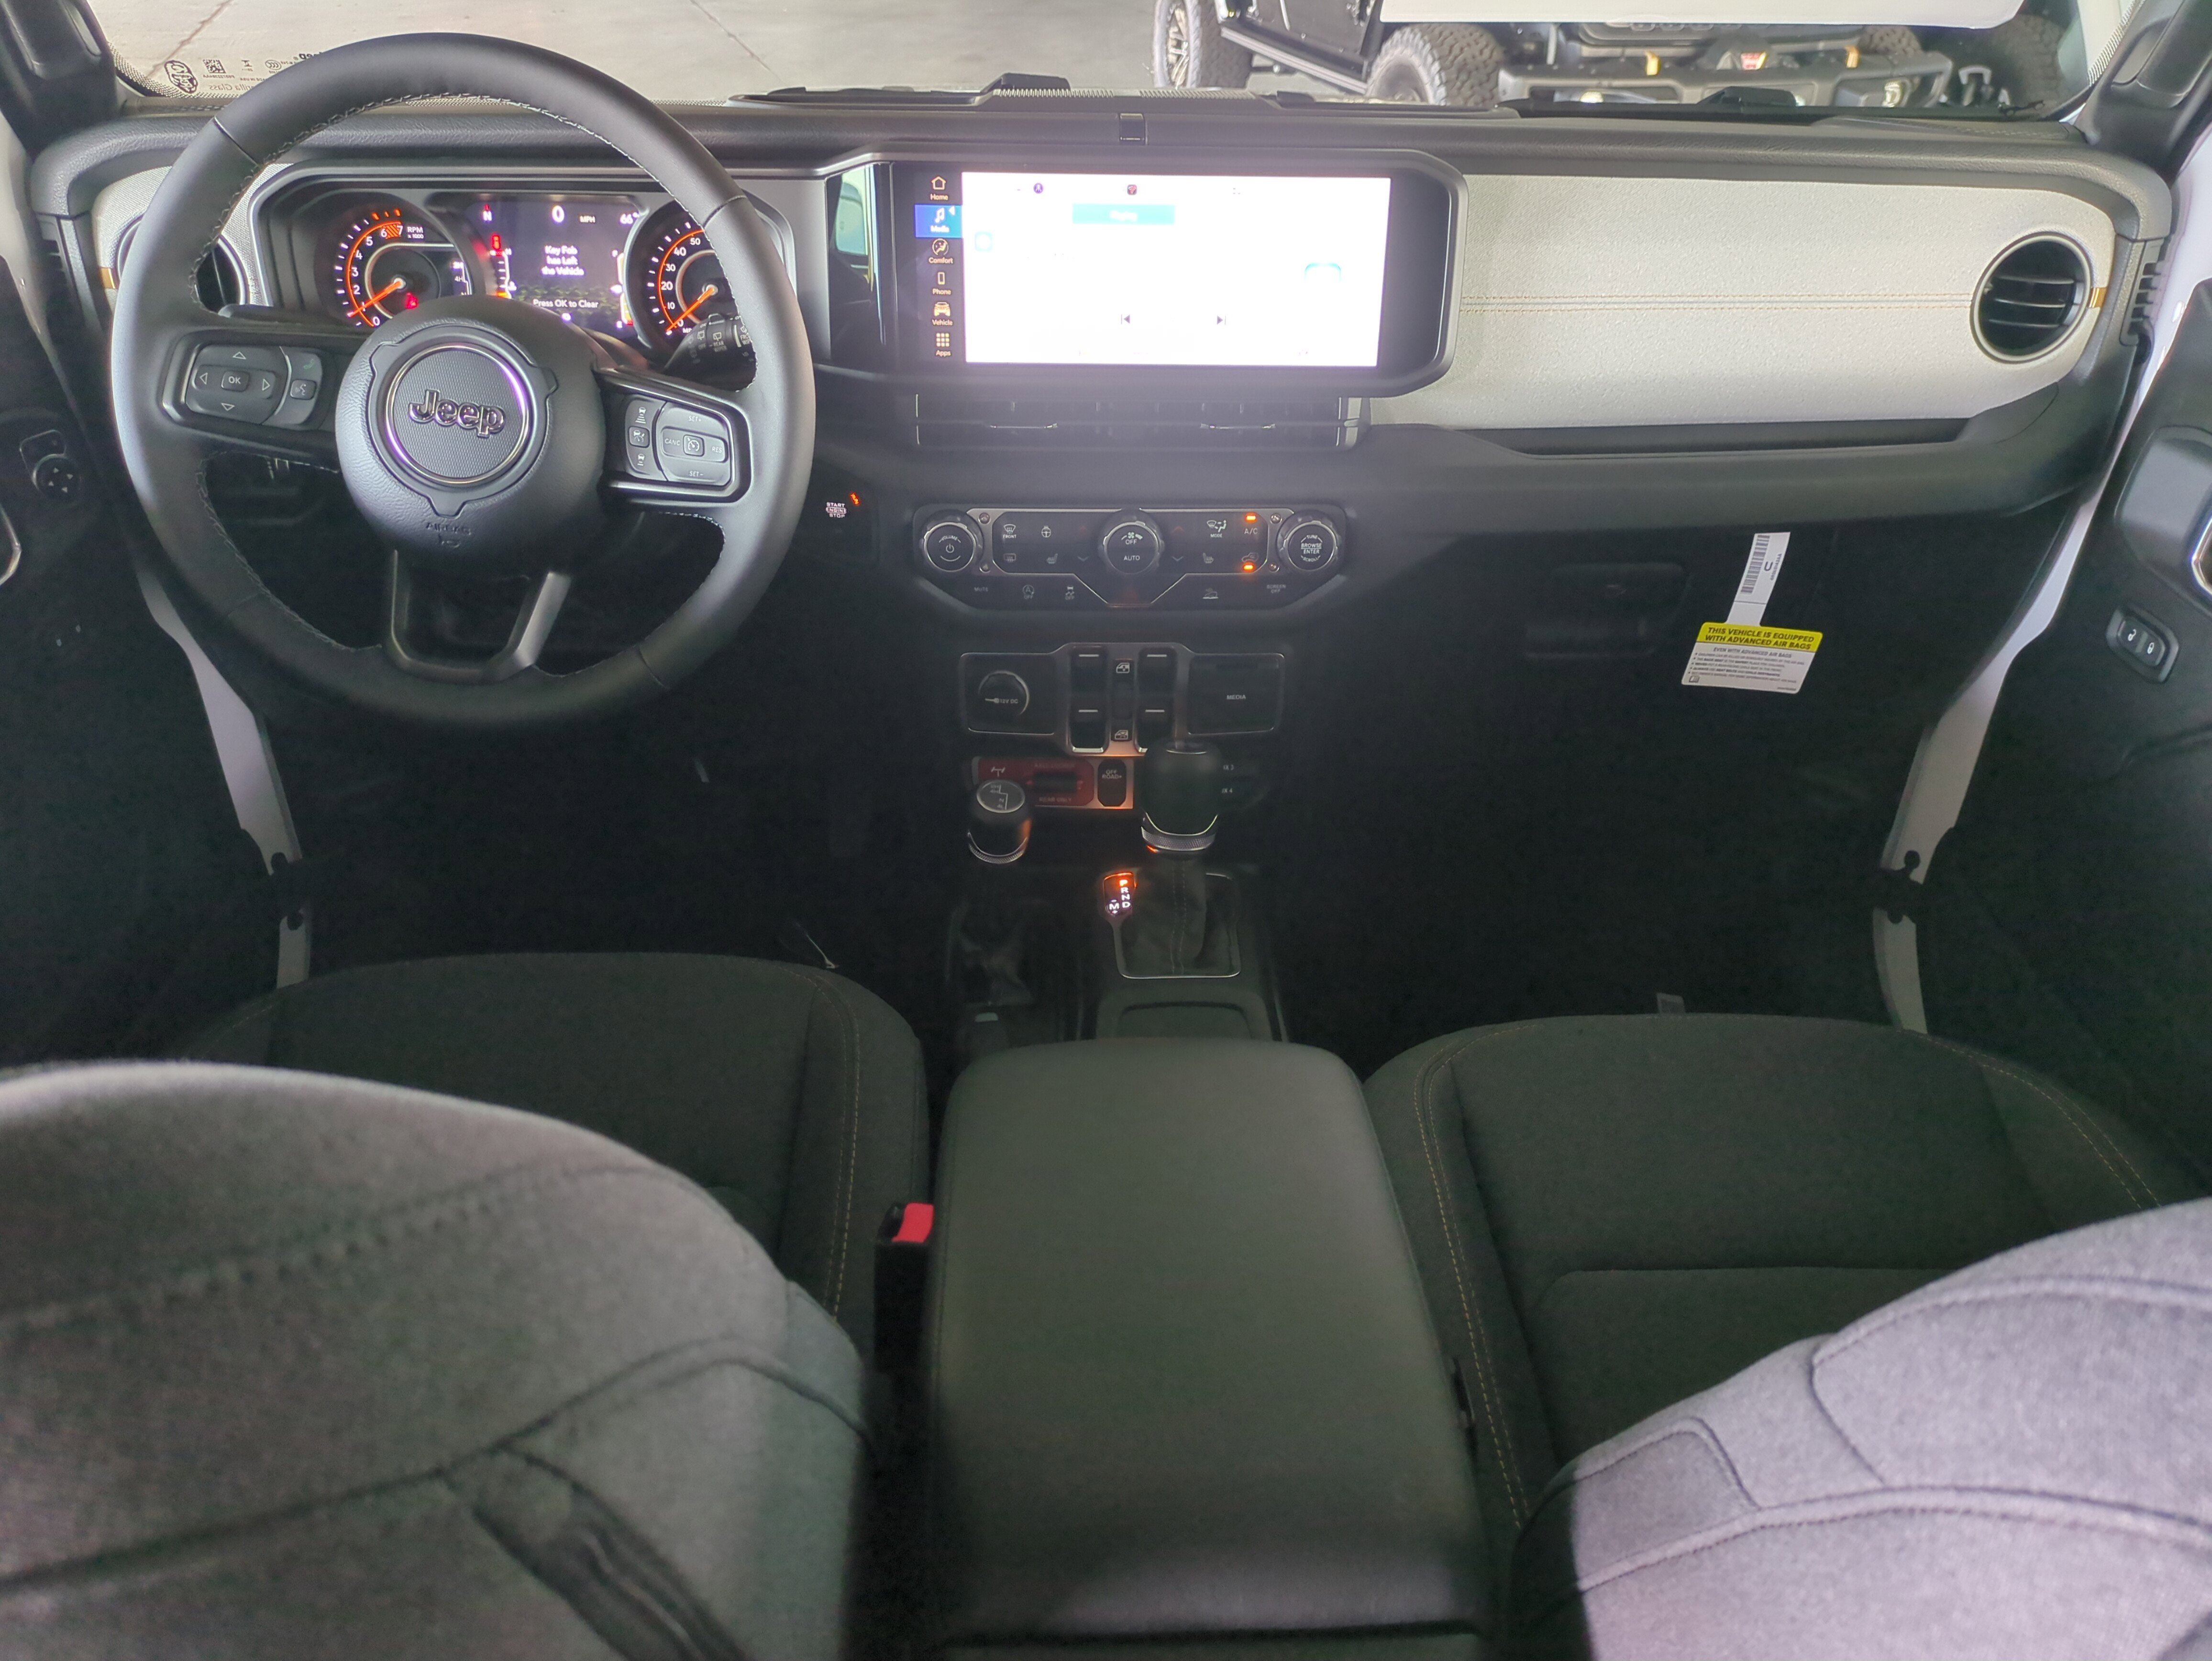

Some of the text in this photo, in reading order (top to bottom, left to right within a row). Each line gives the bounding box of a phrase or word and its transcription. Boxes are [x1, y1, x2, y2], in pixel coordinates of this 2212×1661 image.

[552, 205, 565, 222] 0
[380, 228, 387, 238] 6
[398, 226, 404, 235] 7
[366, 237, 373, 245] 5
[544, 245, 578, 256] Key Fob
[674, 247, 686, 256] 40
[355, 251, 363, 260] 4
[352, 267, 358, 277] 3
[555, 266, 585, 276] Vehicle
[353, 286, 360, 294] 2
[661, 281, 673, 290] 20
[533, 299, 553, 308] Press
[578, 300, 598, 308] Clear
[373, 316, 380, 326] 0
[229, 376, 241, 384] OK
[409, 389, 506, 438] Jeep
[664, 437, 680, 446] CANC
[1728, 629, 1762, 637] VEHICLE
[1773, 632, 1814, 642] EQUIPPED
[1727, 636, 1772, 646] ADVANCED
[1789, 642, 1812, 650] BAGS
[1109, 902, 1120, 910] M
